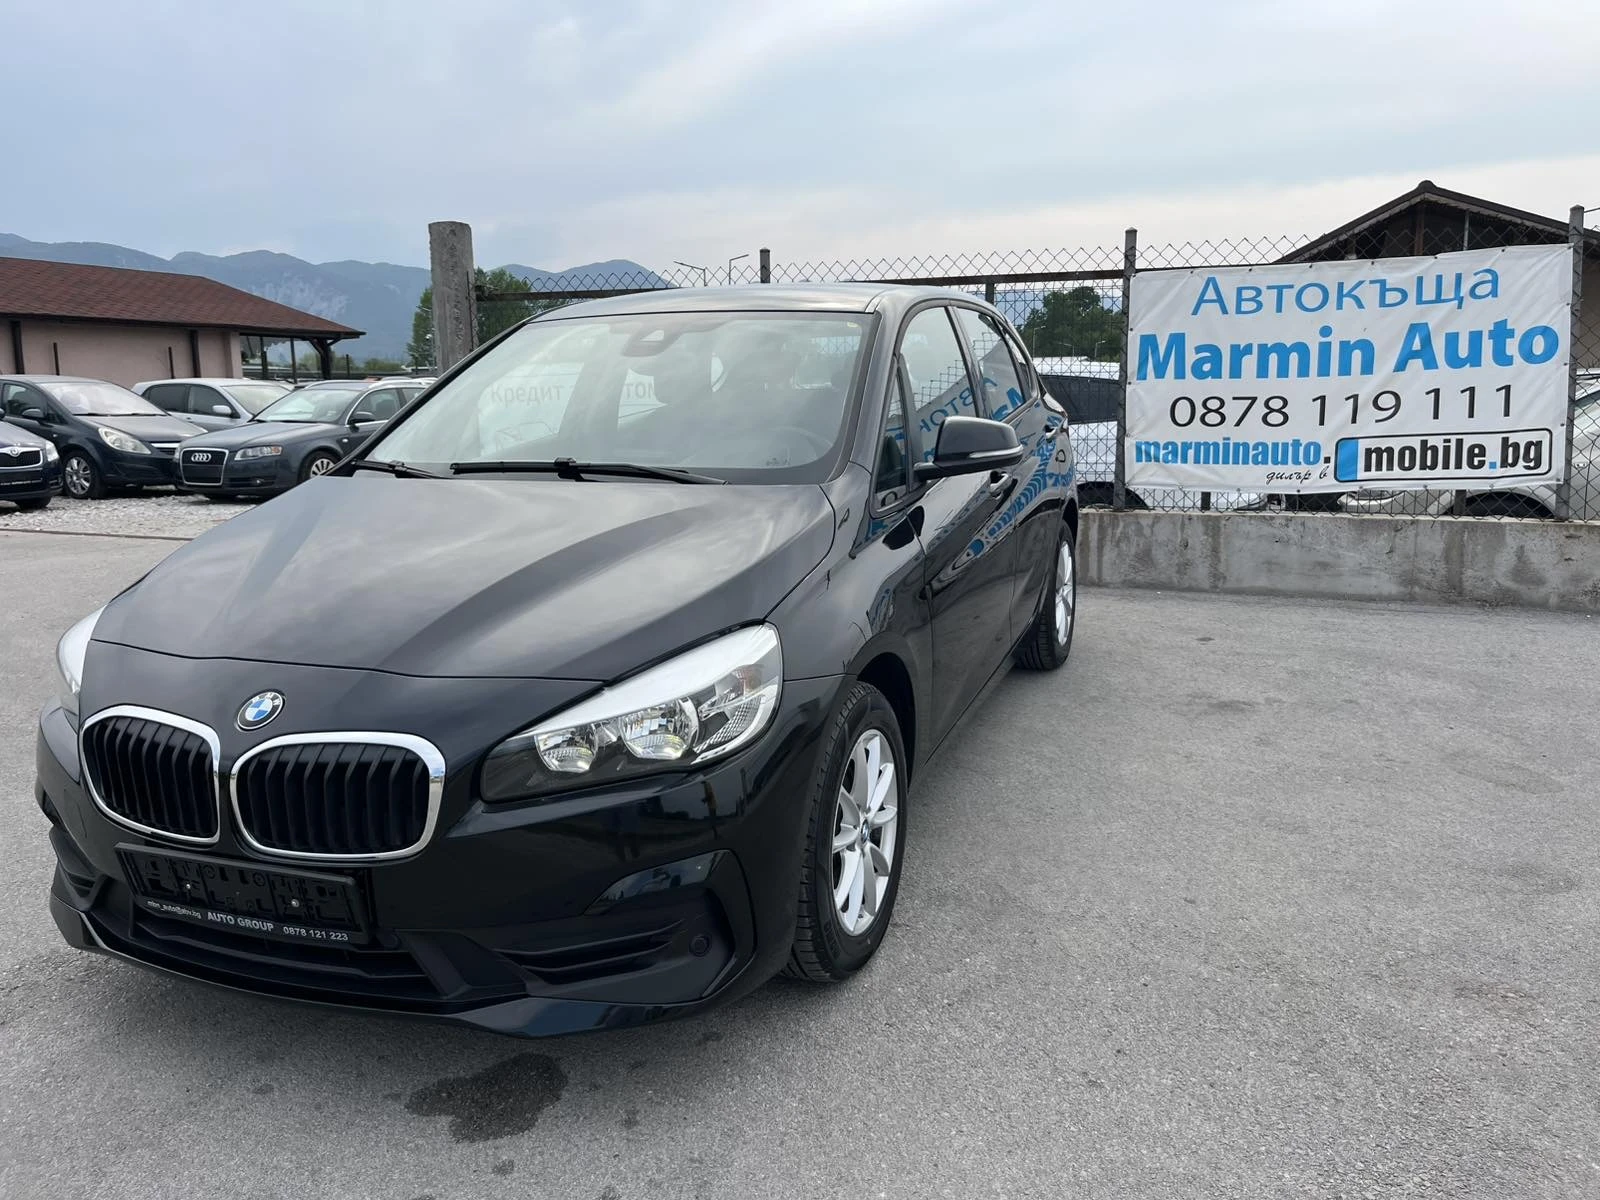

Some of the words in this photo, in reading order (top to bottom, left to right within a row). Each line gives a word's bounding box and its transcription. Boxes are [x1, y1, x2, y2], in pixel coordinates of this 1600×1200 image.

[1190, 267, 1500, 317] Автокъща
[1136, 325, 1376, 382] Marmin
[1393, 318, 1560, 373] Auto
[1169, 395, 1290, 428] 0878
[1312, 390, 1402, 426] 119
[1425, 384, 1512, 420] 111
[1363, 437, 1543, 473] mobile.bg
[207, 911, 235, 925] AUTO
[237, 917, 274, 932] GROUP
[283, 926, 307, 936] 0878
[309, 929, 326, 938] 121
[329, 931, 348, 941] 223
